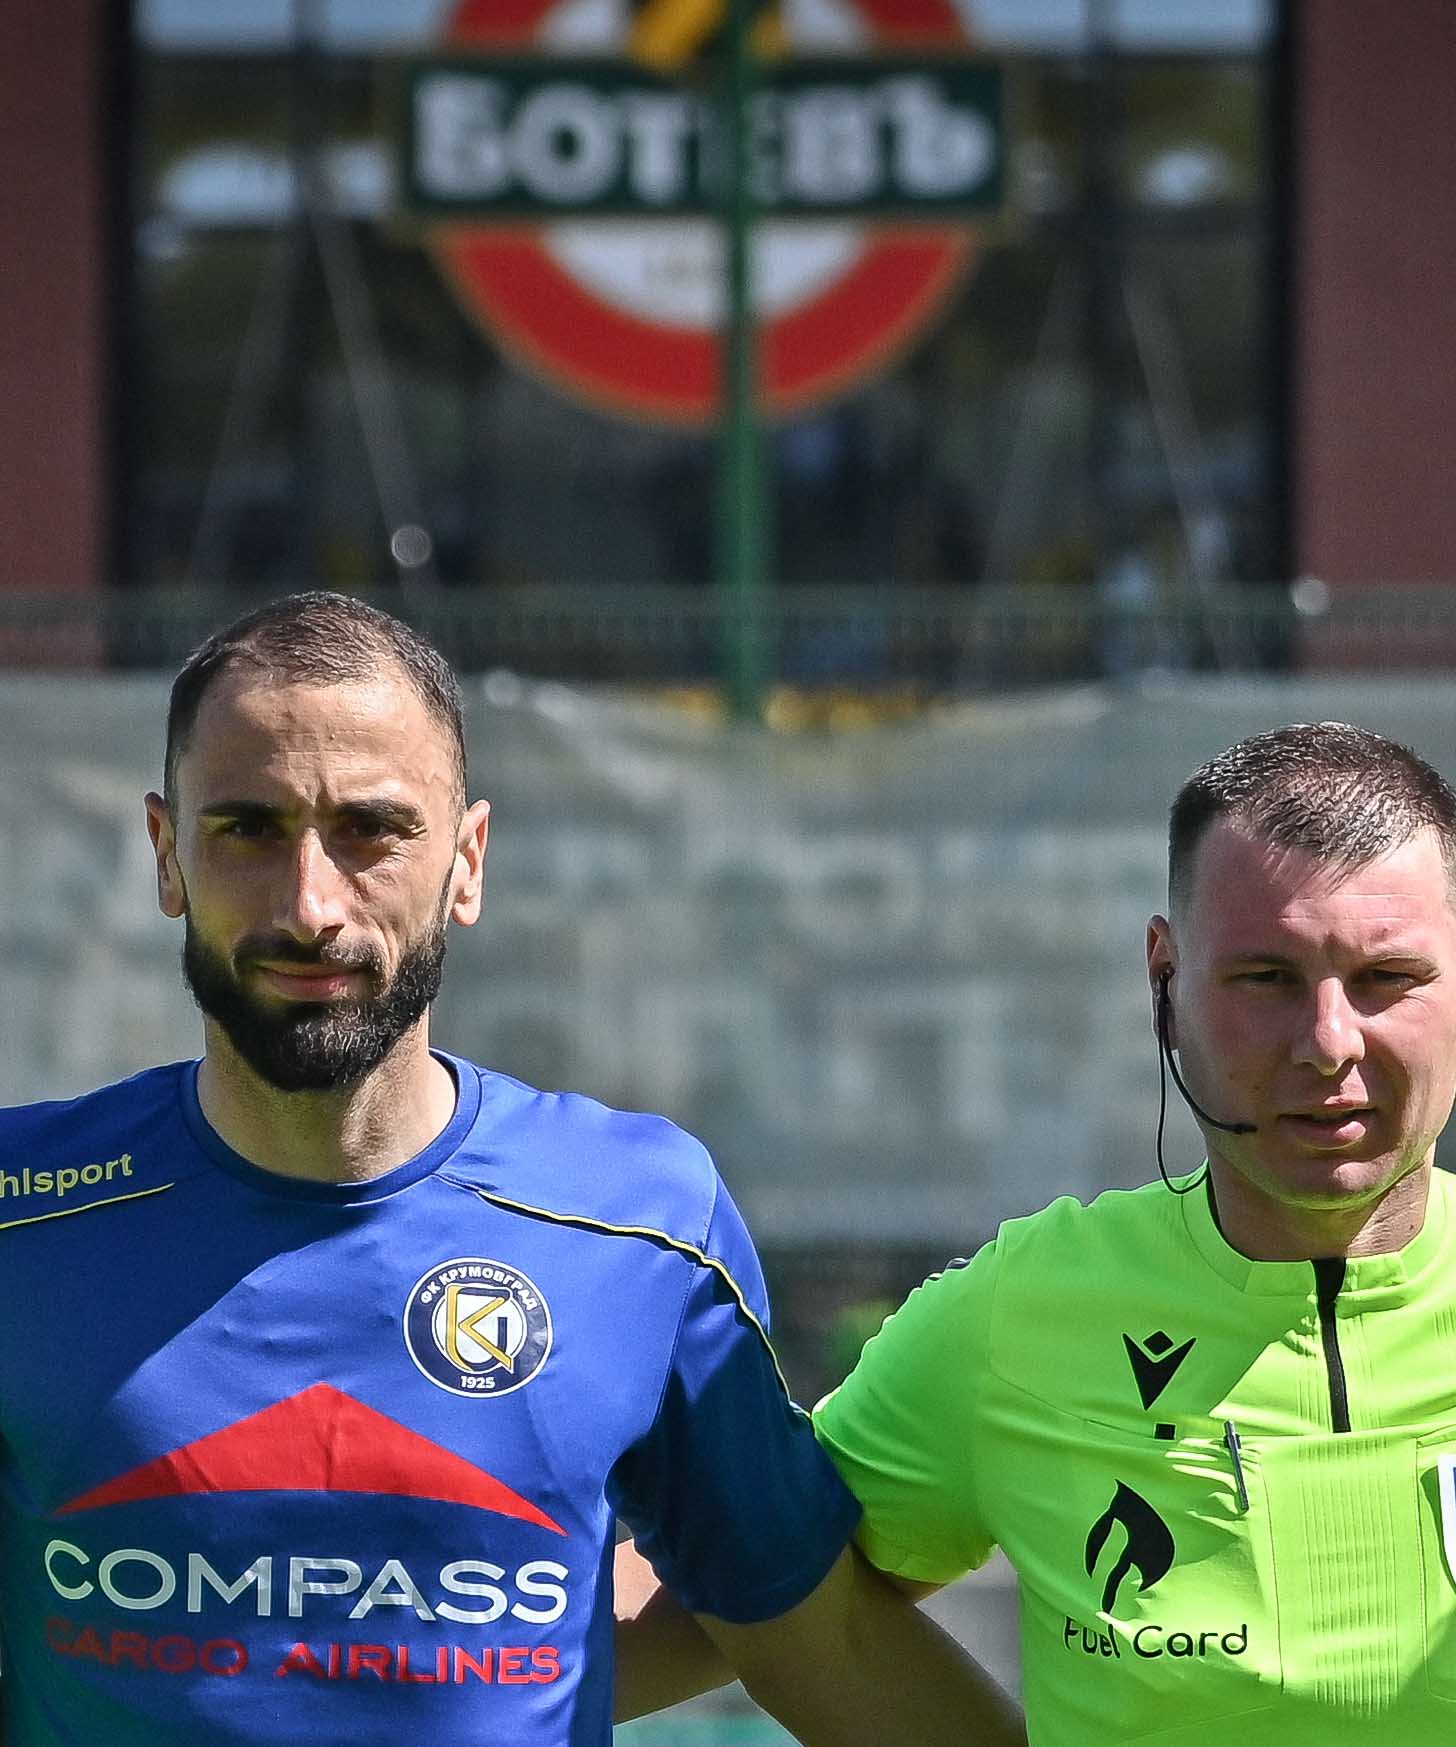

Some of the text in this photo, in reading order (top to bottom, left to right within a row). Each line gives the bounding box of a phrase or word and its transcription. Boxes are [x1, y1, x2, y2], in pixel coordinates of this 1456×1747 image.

[420, 1266, 539, 1311] ФК КРУМОВГРАД
[460, 1375, 496, 1389] 1925
[44, 1538, 570, 1626] COMPASS
[46, 1615, 562, 1686] CARGO AIRLINES
[1063, 1615, 1248, 1659] Fuel Card
